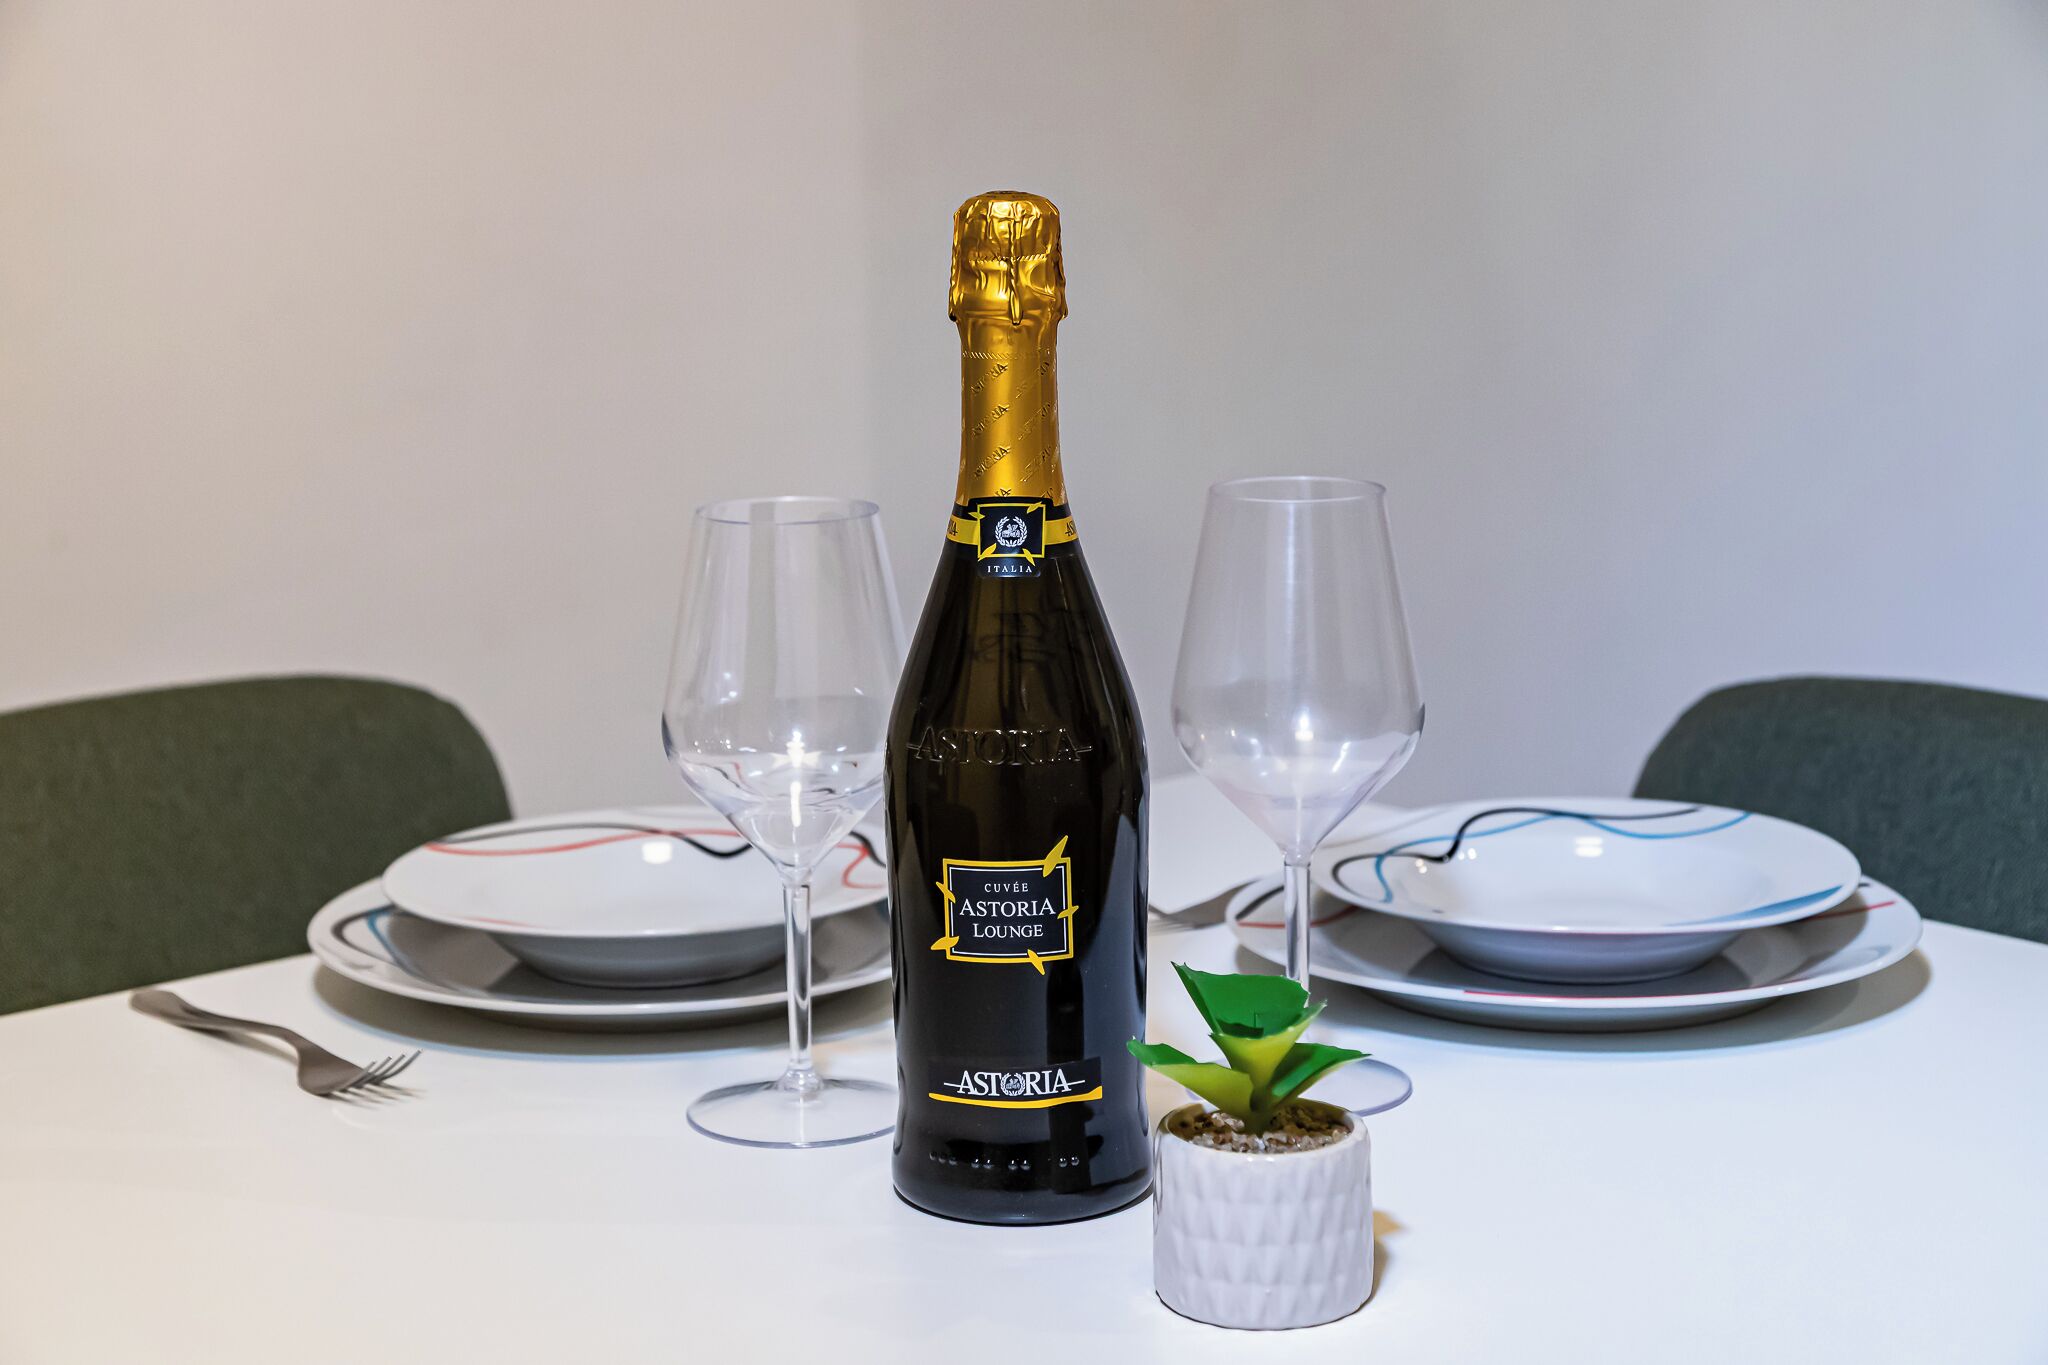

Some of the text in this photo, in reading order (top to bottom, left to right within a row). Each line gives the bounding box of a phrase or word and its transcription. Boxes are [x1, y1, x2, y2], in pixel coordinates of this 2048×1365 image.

[987, 565, 1033, 573] ITALIA
[906, 725, 1092, 766] ASTORIA
[984, 881, 1029, 893] CUVÉE
[959, 897, 1057, 917] ASTORIA
[972, 923, 1044, 938] LOUNGE
